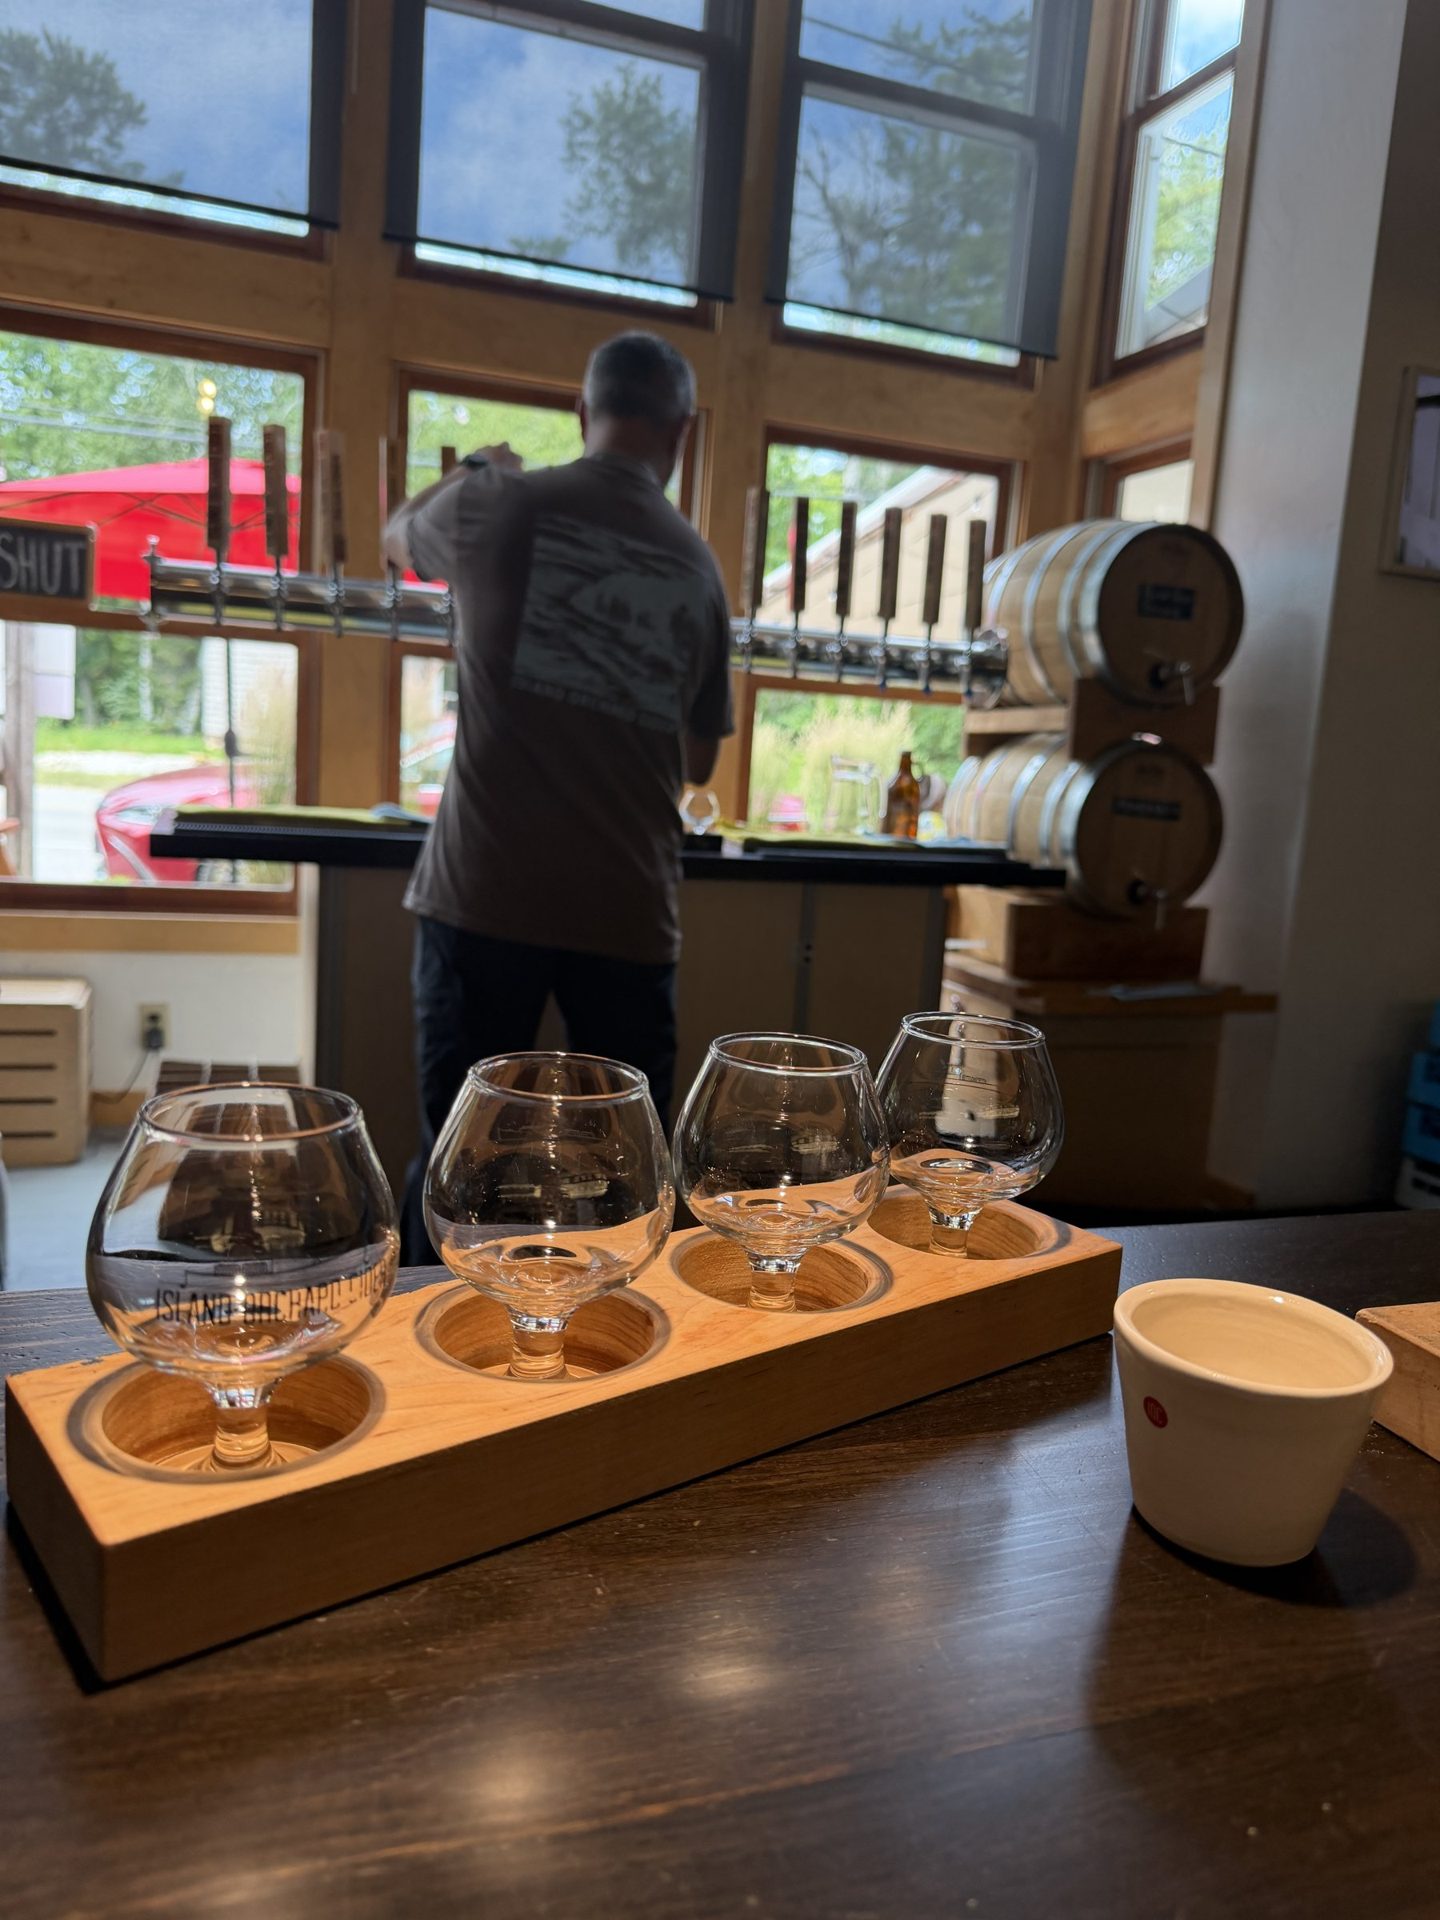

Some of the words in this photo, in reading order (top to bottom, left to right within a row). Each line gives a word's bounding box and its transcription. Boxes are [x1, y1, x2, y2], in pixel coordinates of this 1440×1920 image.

[0, 531, 86, 595] SHUT
[156, 1288, 232, 1325] ISLAND
[243, 1278, 341, 1324] ORCHARD
